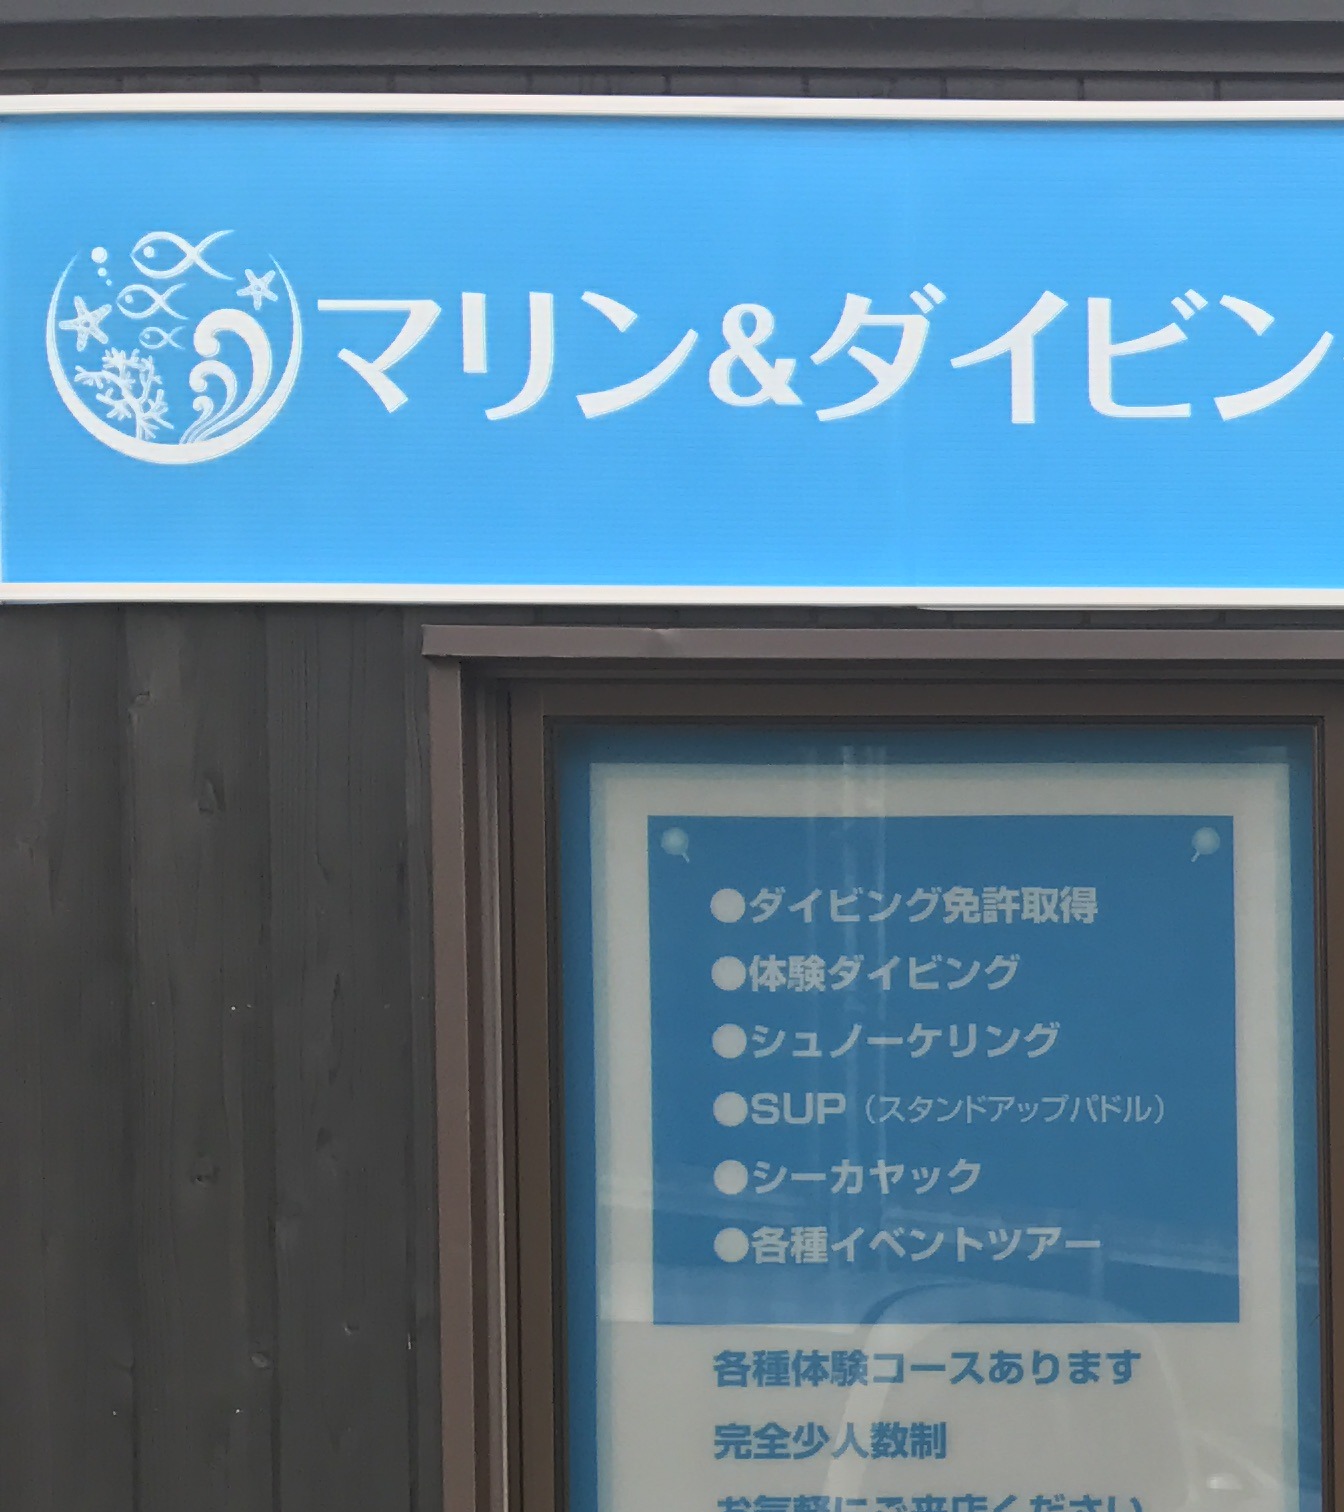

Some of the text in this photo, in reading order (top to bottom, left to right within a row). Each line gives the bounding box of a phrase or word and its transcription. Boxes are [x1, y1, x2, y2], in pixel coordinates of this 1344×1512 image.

[749, 886, 1099, 924] ダイビング免許取得
[749, 954, 1020, 993] 体験ダイビング
[751, 1022, 1061, 1059] シュノーケリング
[751, 1158, 982, 1195] シーカヤック
[750, 1226, 1101, 1265] 各種イベントツアー
[712, 1349, 1143, 1389] 各種体験コースあります
[714, 1421, 948, 1460] 完全少人数制
